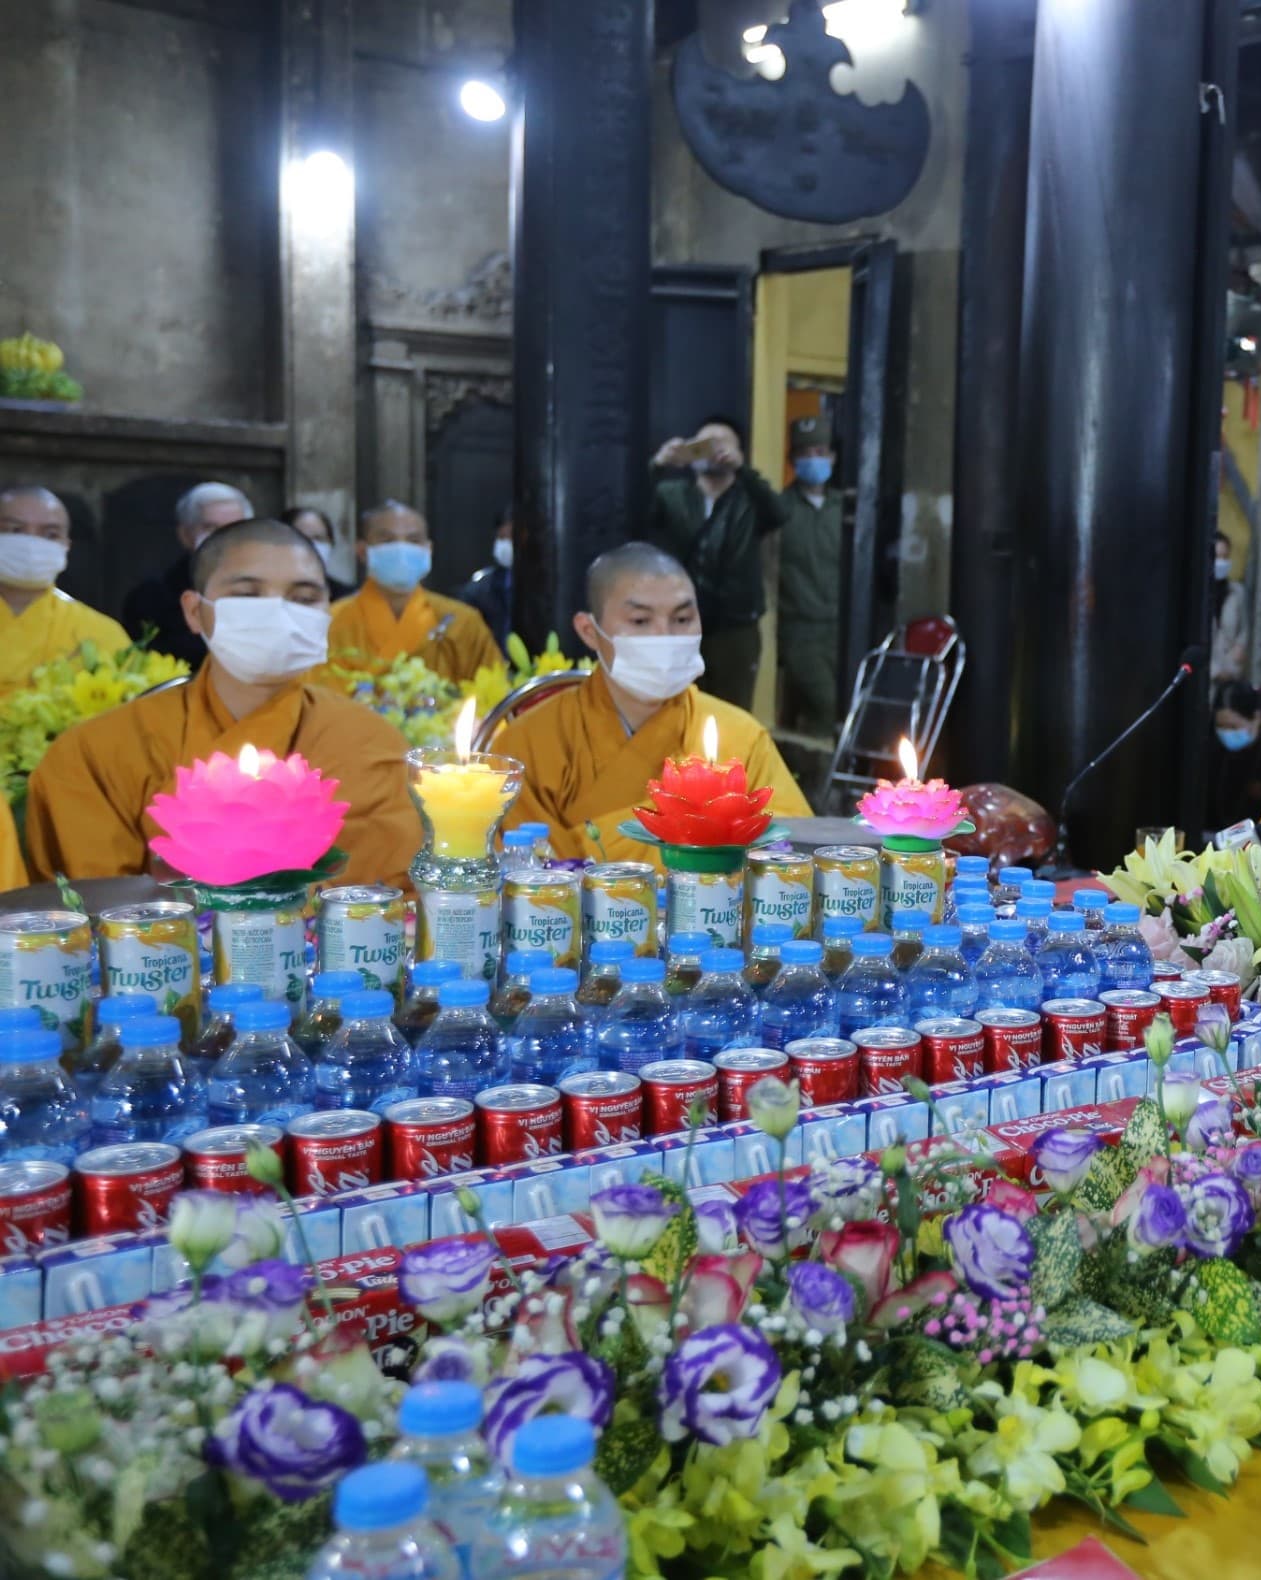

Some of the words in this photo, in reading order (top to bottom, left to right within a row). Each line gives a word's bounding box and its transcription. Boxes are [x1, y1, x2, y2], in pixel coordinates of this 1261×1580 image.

[819, 893, 876, 915] Twister
[881, 886, 937, 907] Twister
[608, 908, 644, 919] Tropicana
[700, 908, 740, 926] Twis
[752, 897, 810, 920] Twister
[529, 915, 568, 927] Tropicana
[585, 914, 648, 937] Twister
[504, 921, 571, 947] Twister
[142, 954, 189, 969] Tropicana
[108, 964, 193, 991] Twister
